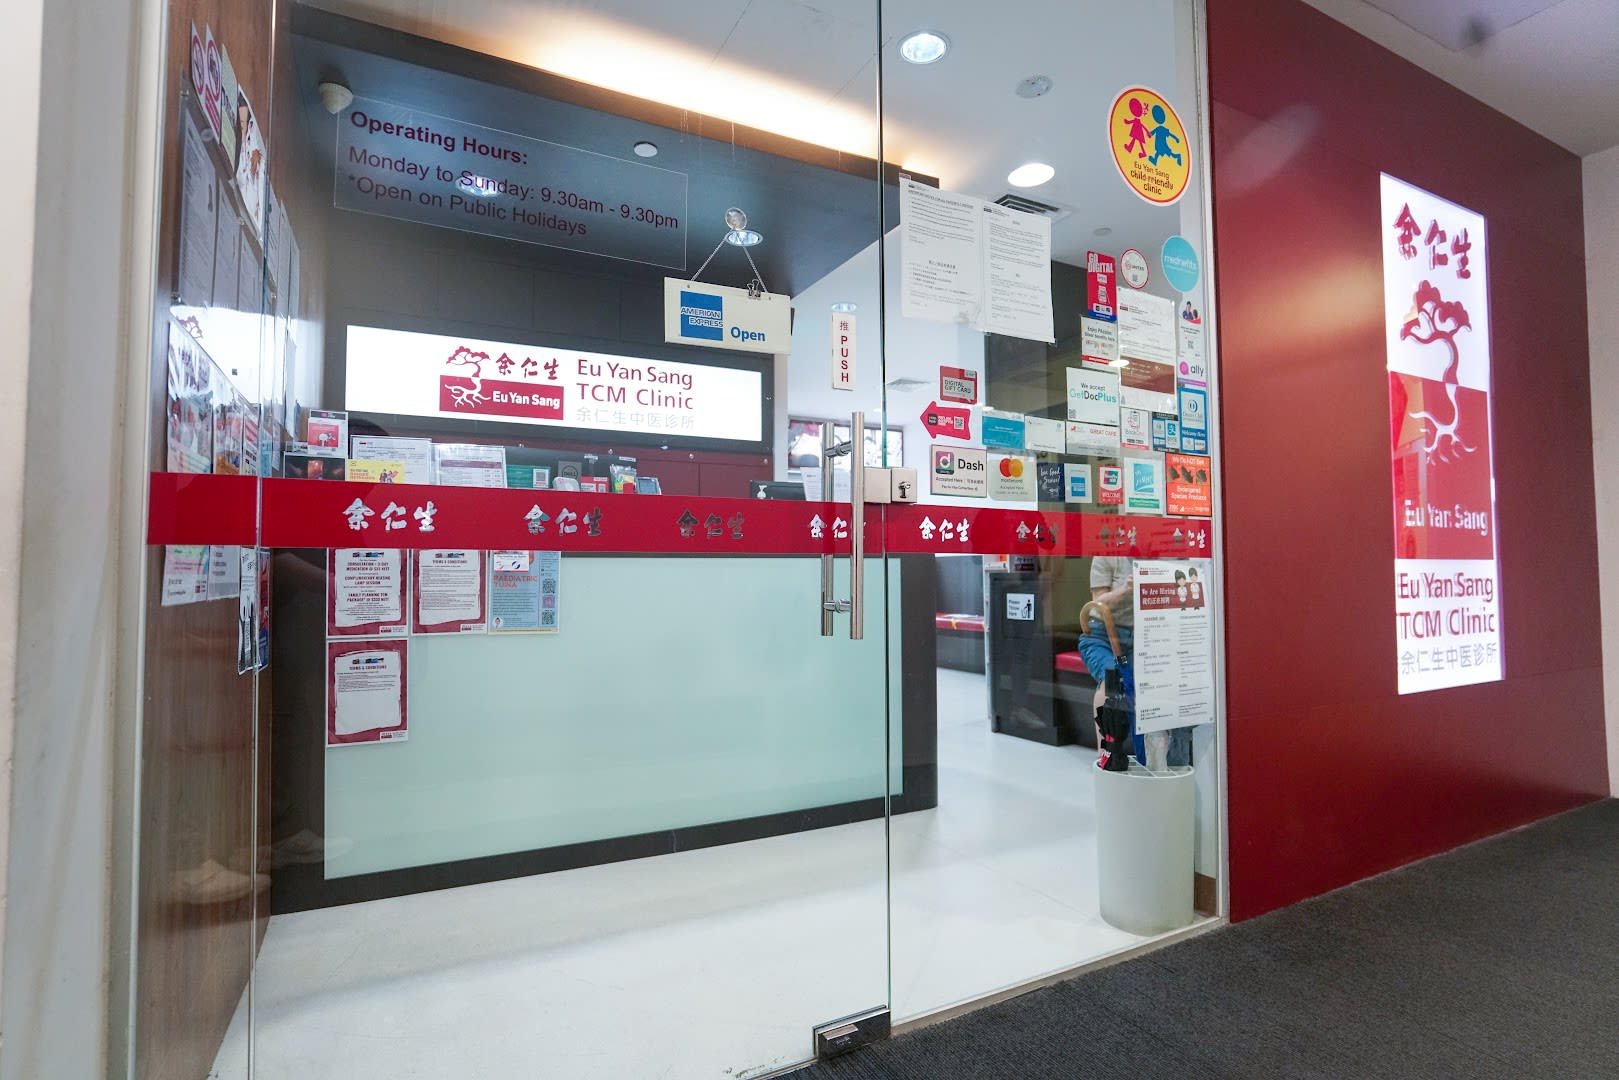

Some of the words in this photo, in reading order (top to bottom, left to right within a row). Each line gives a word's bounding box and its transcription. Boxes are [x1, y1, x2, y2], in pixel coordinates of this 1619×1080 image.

[350, 111, 456, 152] Operating
[462, 137, 528, 165] Hours:
[1134, 161, 1142, 170] Eu
[1143, 164, 1154, 174] Yan
[1155, 168, 1170, 181] Sang
[349, 146, 430, 182] Monday
[436, 165, 454, 184] to
[460, 170, 535, 201] Sunday:
[541, 186, 605, 214] 9.30am
[620, 203, 680, 230] 9.30pm
[419, 190, 443, 208] on
[449, 194, 507, 222] Public
[512, 206, 588, 236] Holidays
[1393, 203, 1472, 280] 余仁生
[1088, 262, 1114, 273] DIGITAL
[680, 306, 722, 319] AMERICAN
[689, 317, 724, 327] EXPRESS
[730, 326, 766, 342] Open
[495, 351, 561, 382] 余仁生
[577, 357, 601, 379] Eu
[605, 362, 643, 383] Yan
[646, 365, 694, 392] Sang
[840, 335, 849, 383] PUSH
[1190, 365, 1204, 376] ally
[576, 383, 627, 404] TCM
[636, 387, 694, 411] Clinic
[944, 379, 964, 388] DIGITAL
[492, 390, 508, 403] Eu
[508, 391, 531, 405] Yan
[531, 393, 561, 411] Sang
[958, 458, 984, 472] Dash
[342, 497, 438, 532] 余仁生
[523, 504, 602, 537] 余仁生
[676, 508, 745, 540] 余仁生
[809, 513, 862, 540] 余仁
[918, 515, 970, 543] 余仁生
[1404, 499, 1425, 527] Eu
[1427, 503, 1453, 529] Yan
[1454, 504, 1489, 537] Sang
[1398, 572, 1420, 599] Eu
[1422, 572, 1454, 599] Yan
[1453, 572, 1494, 603] Sang
[1396, 610, 1442, 640] TCM
[1446, 607, 1495, 636] Clinic
